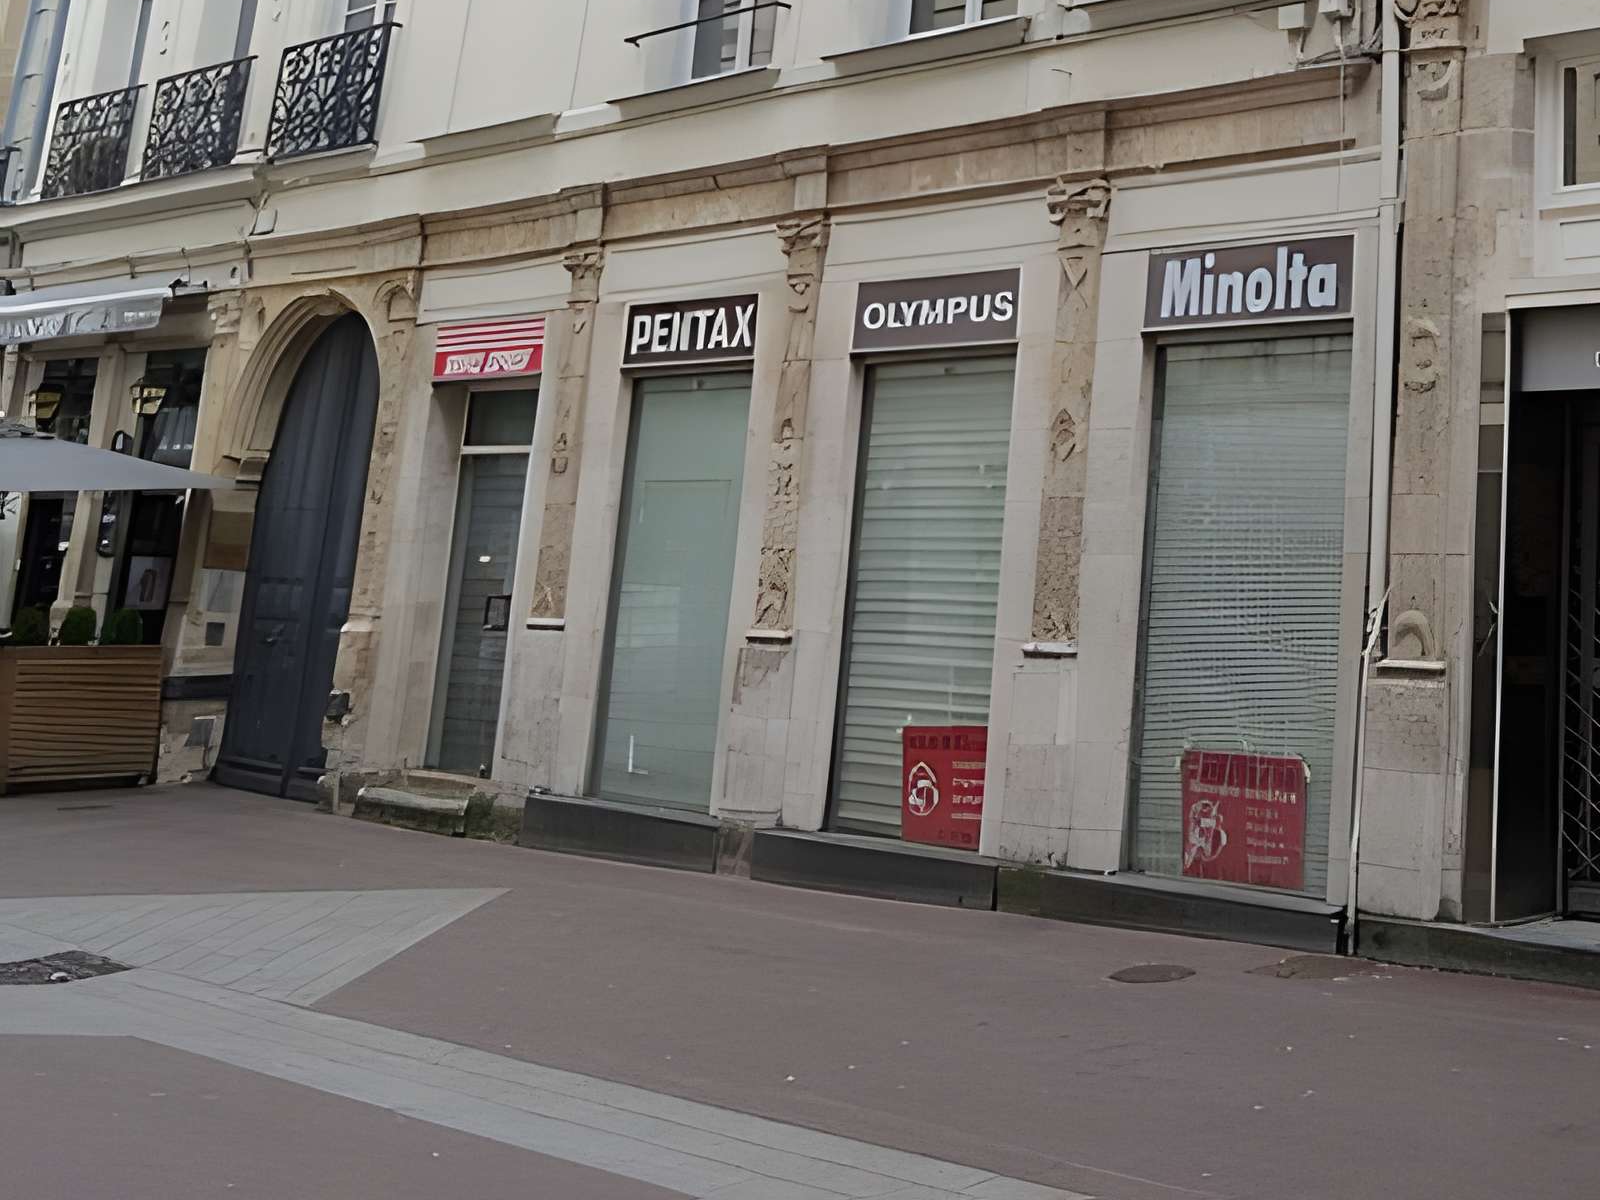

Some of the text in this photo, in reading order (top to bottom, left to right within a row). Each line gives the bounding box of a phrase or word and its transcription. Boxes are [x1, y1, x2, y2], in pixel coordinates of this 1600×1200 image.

[1160, 246, 1337, 318] Minolta
[630, 303, 755, 355] PENTAX
[863, 291, 1013, 329] OLYMPUS
